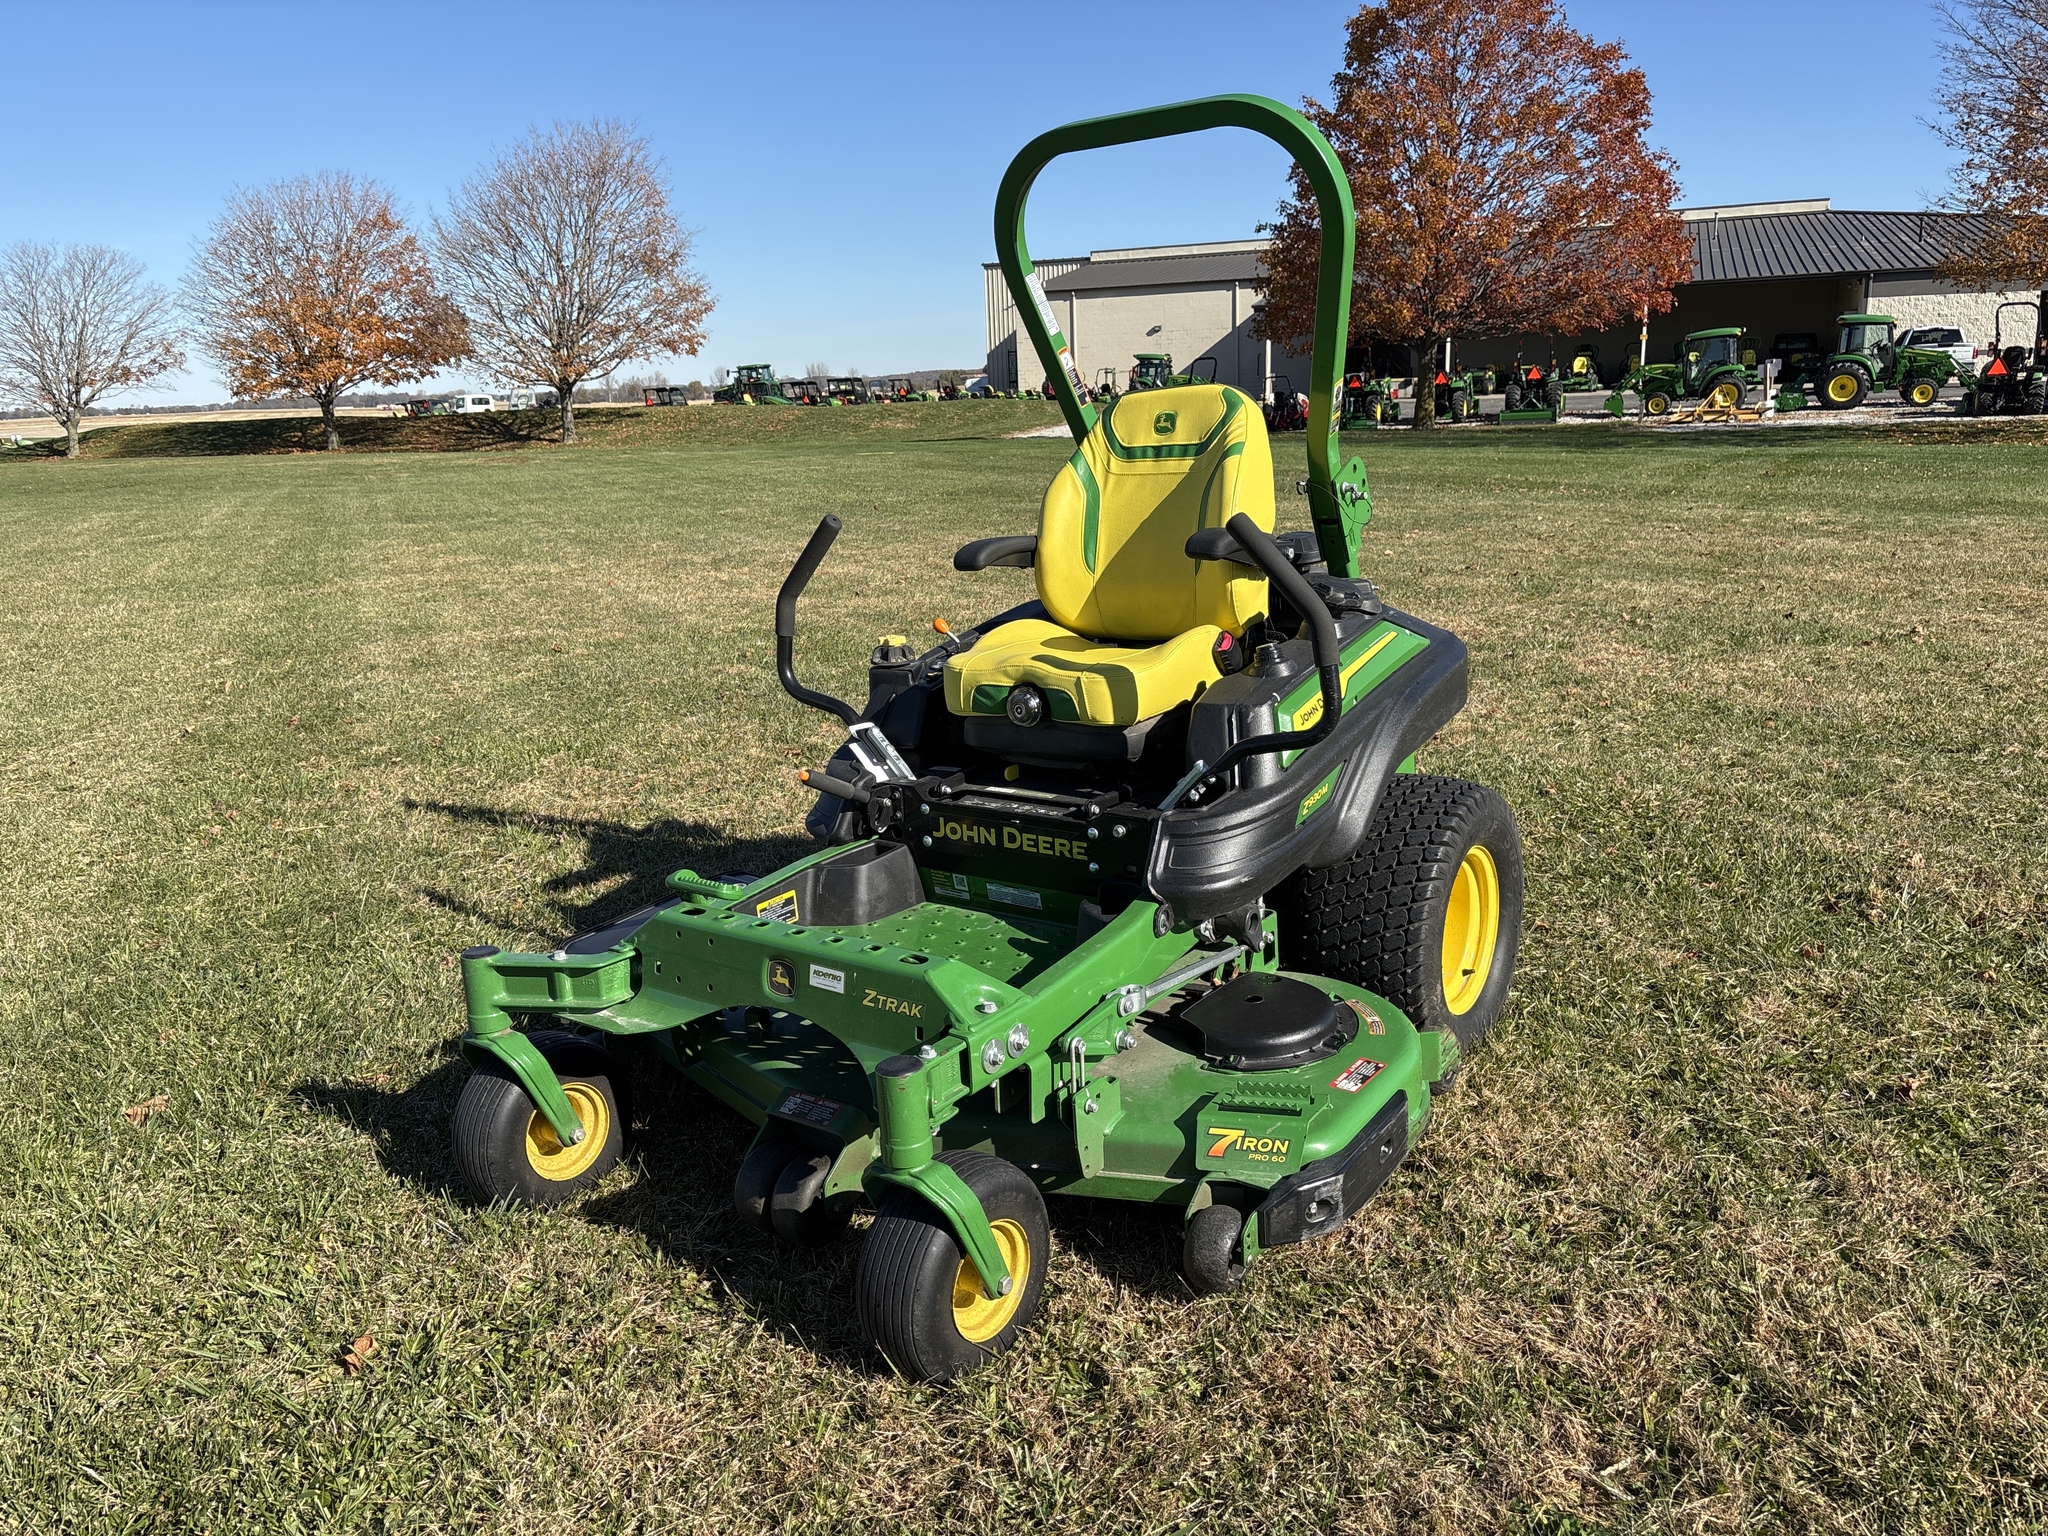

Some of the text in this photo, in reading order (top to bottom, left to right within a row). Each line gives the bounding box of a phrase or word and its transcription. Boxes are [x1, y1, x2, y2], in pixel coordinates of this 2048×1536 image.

[1300, 704, 1320, 726] JOHN
[932, 816, 1089, 861] JOHN DEERE
[862, 988, 923, 1019] ZTRAK
[1248, 1153, 1286, 1163] PRO 60
